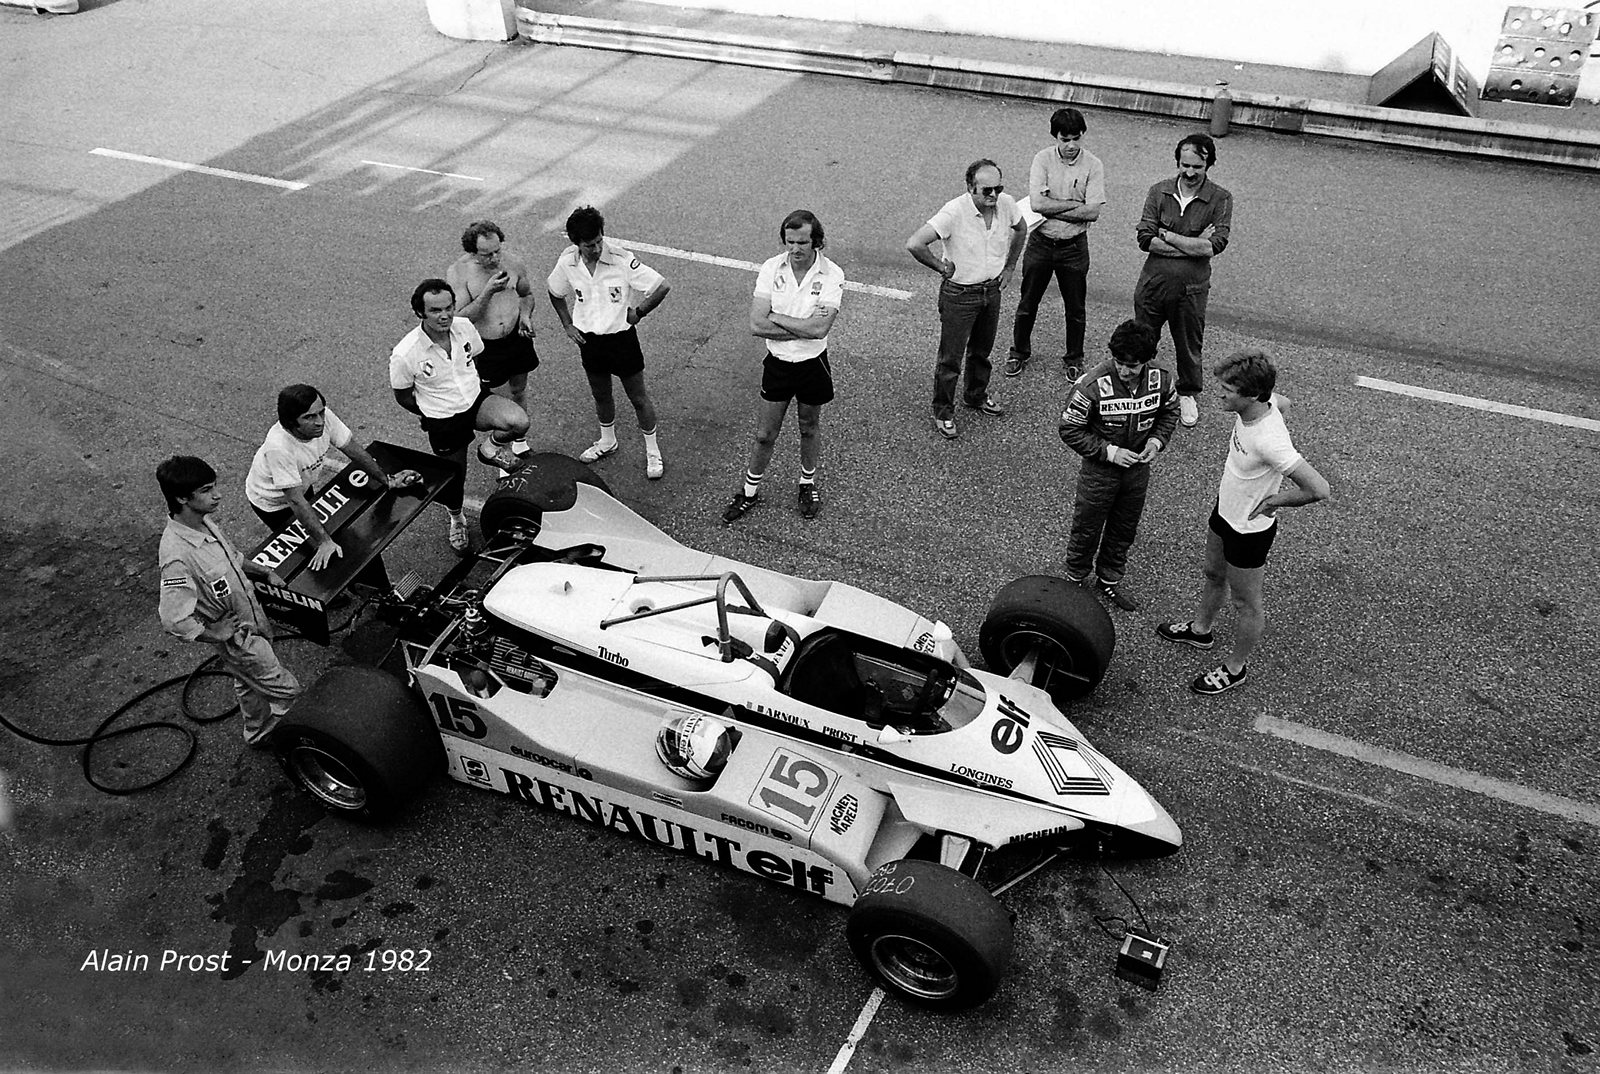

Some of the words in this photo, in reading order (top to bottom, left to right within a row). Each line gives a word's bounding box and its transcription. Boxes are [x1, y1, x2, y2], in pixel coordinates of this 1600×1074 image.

[1101, 401, 1142, 412] RENAULT
[1144, 395, 1159, 407] elf
[254, 581, 324, 612] CHELIN
[597, 645, 630, 667] Turbo
[912, 631, 934, 651] GNETI
[428, 691, 488, 740] 15
[766, 707, 811, 729] ARNOUX
[822, 725, 858, 743] PROST
[991, 694, 1031, 754] elf
[510, 745, 573, 773] europcar
[759, 754, 829, 826] 15
[950, 763, 1014, 789] LONGINES
[829, 793, 855, 833] MAGNETI
[832, 795, 859, 836] MARELLI
[499, 767, 741, 868] RENAULT
[745, 849, 834, 897] elf
[1009, 826, 1068, 844] MICHELIN
